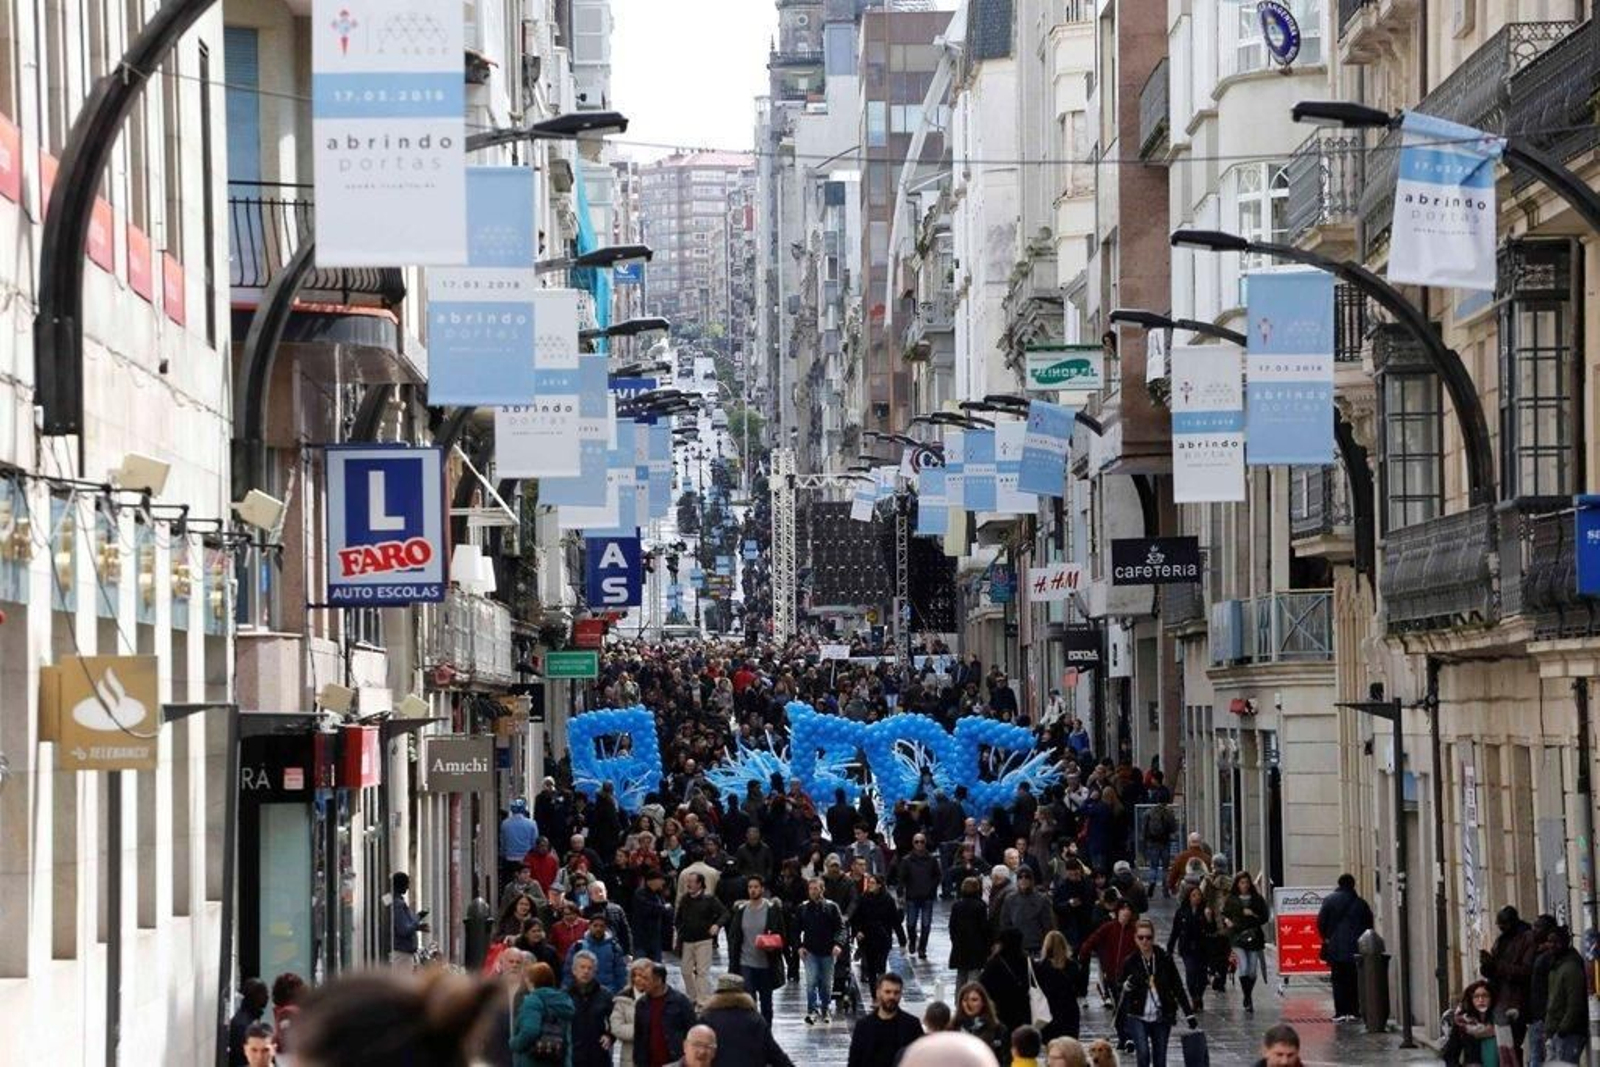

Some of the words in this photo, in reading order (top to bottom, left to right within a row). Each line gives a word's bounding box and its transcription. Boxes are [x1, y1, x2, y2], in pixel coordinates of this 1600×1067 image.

[326, 134, 452, 150] abrindo
[339, 156, 441, 173] portas
[1405, 193, 1487, 210] abrindo
[436, 312, 526, 325] abrindo
[1254, 388, 1327, 400] abrindo
[1178, 440, 1239, 449] abrindo
[368, 470, 405, 531] L
[338, 538, 432, 577] FARO
[332, 587, 373, 599] AUTO
[377, 586, 440, 598] ESCOLAS
[432, 757, 488, 773] Amichi
